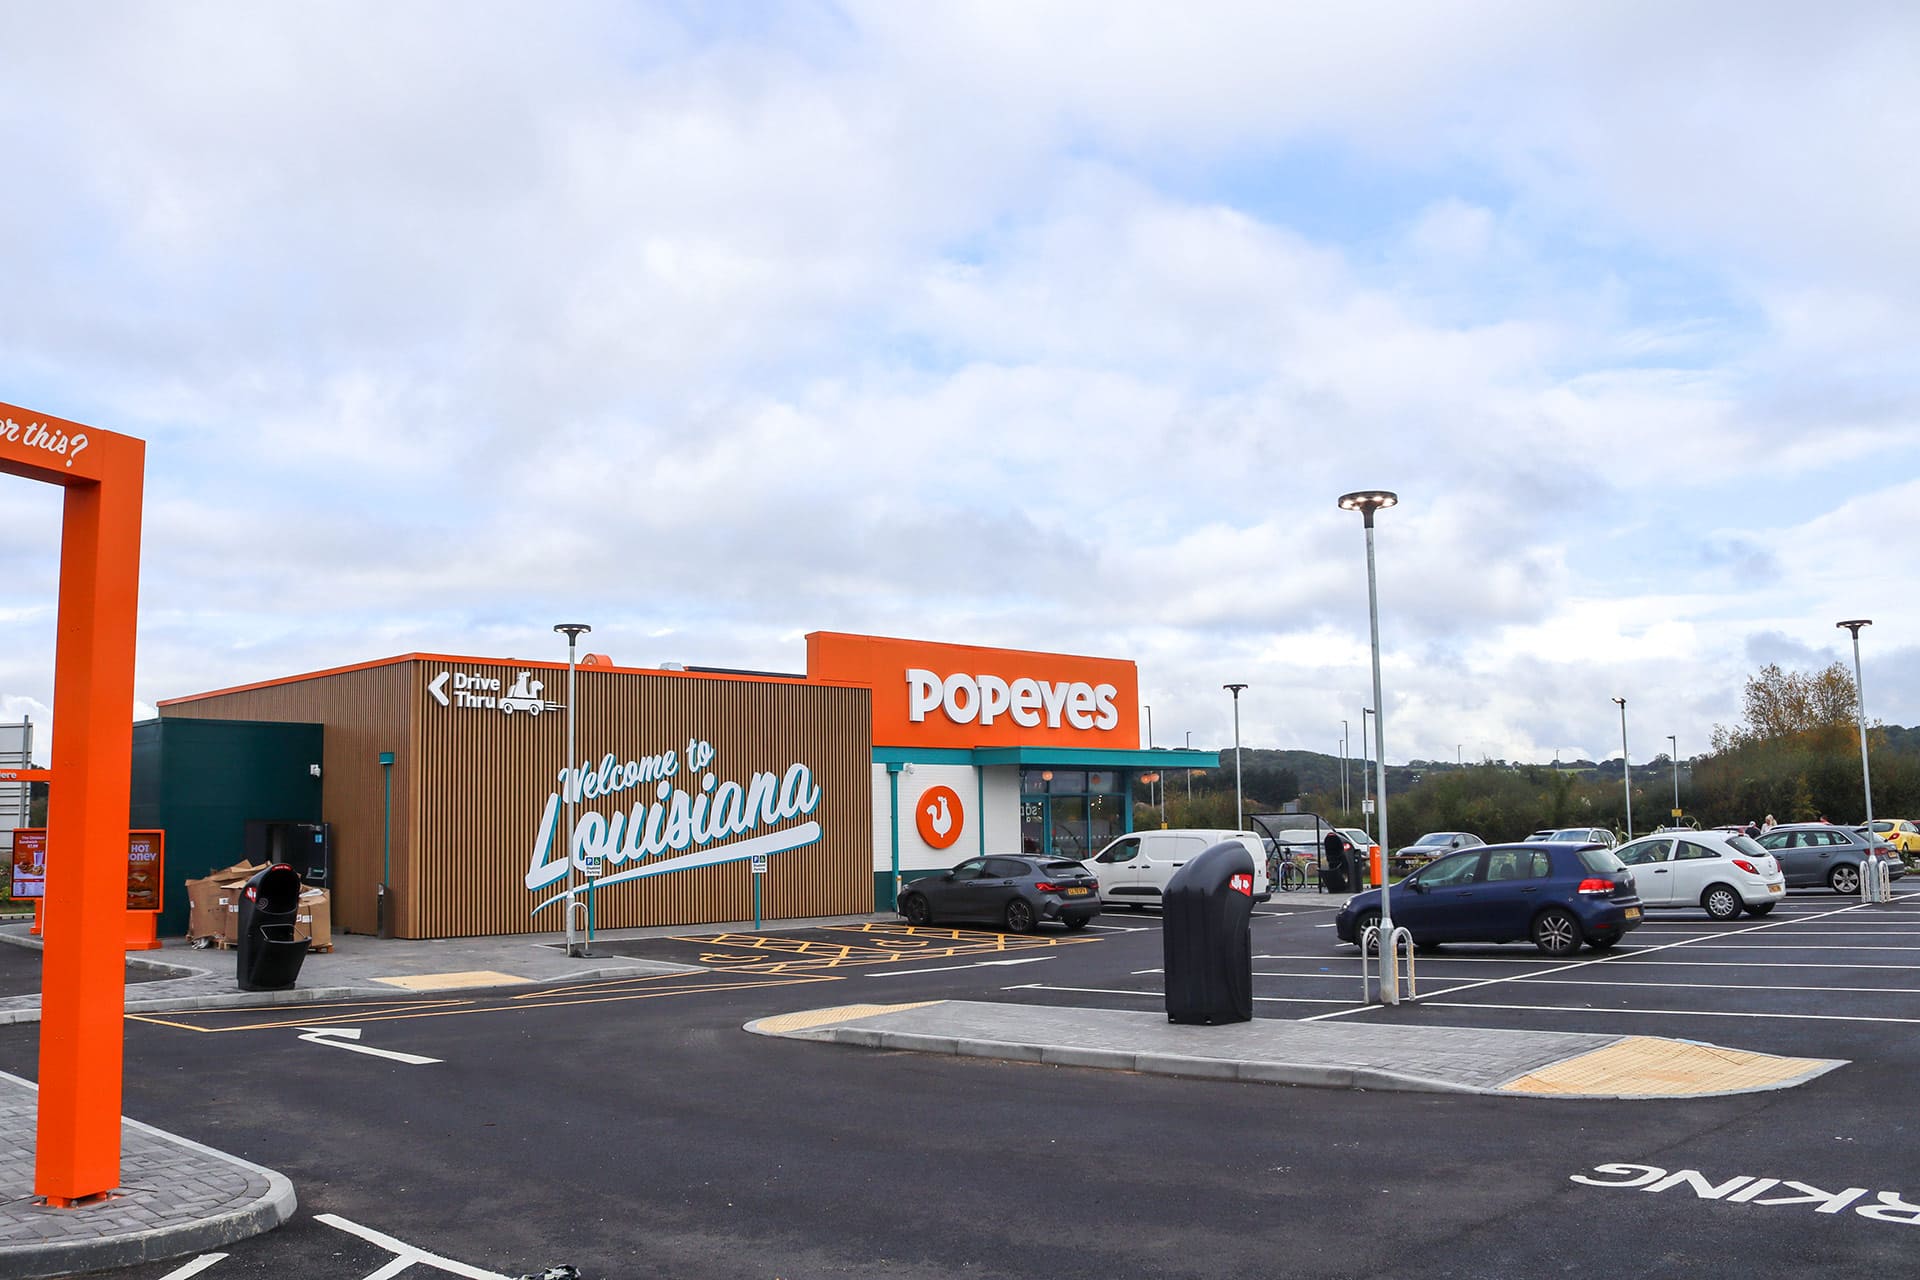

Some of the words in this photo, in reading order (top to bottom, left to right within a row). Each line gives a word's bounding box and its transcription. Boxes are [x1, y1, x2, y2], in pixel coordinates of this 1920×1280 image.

[23, 422, 89, 467] this?
[453, 672, 500, 690] Drive
[453, 690, 496, 709] Thru
[557, 750, 679, 804] Welcome
[686, 737, 716, 773] to
[525, 762, 822, 892] Louisiana
[128, 852, 157, 861] oney
[131, 844, 150, 853] HOT
